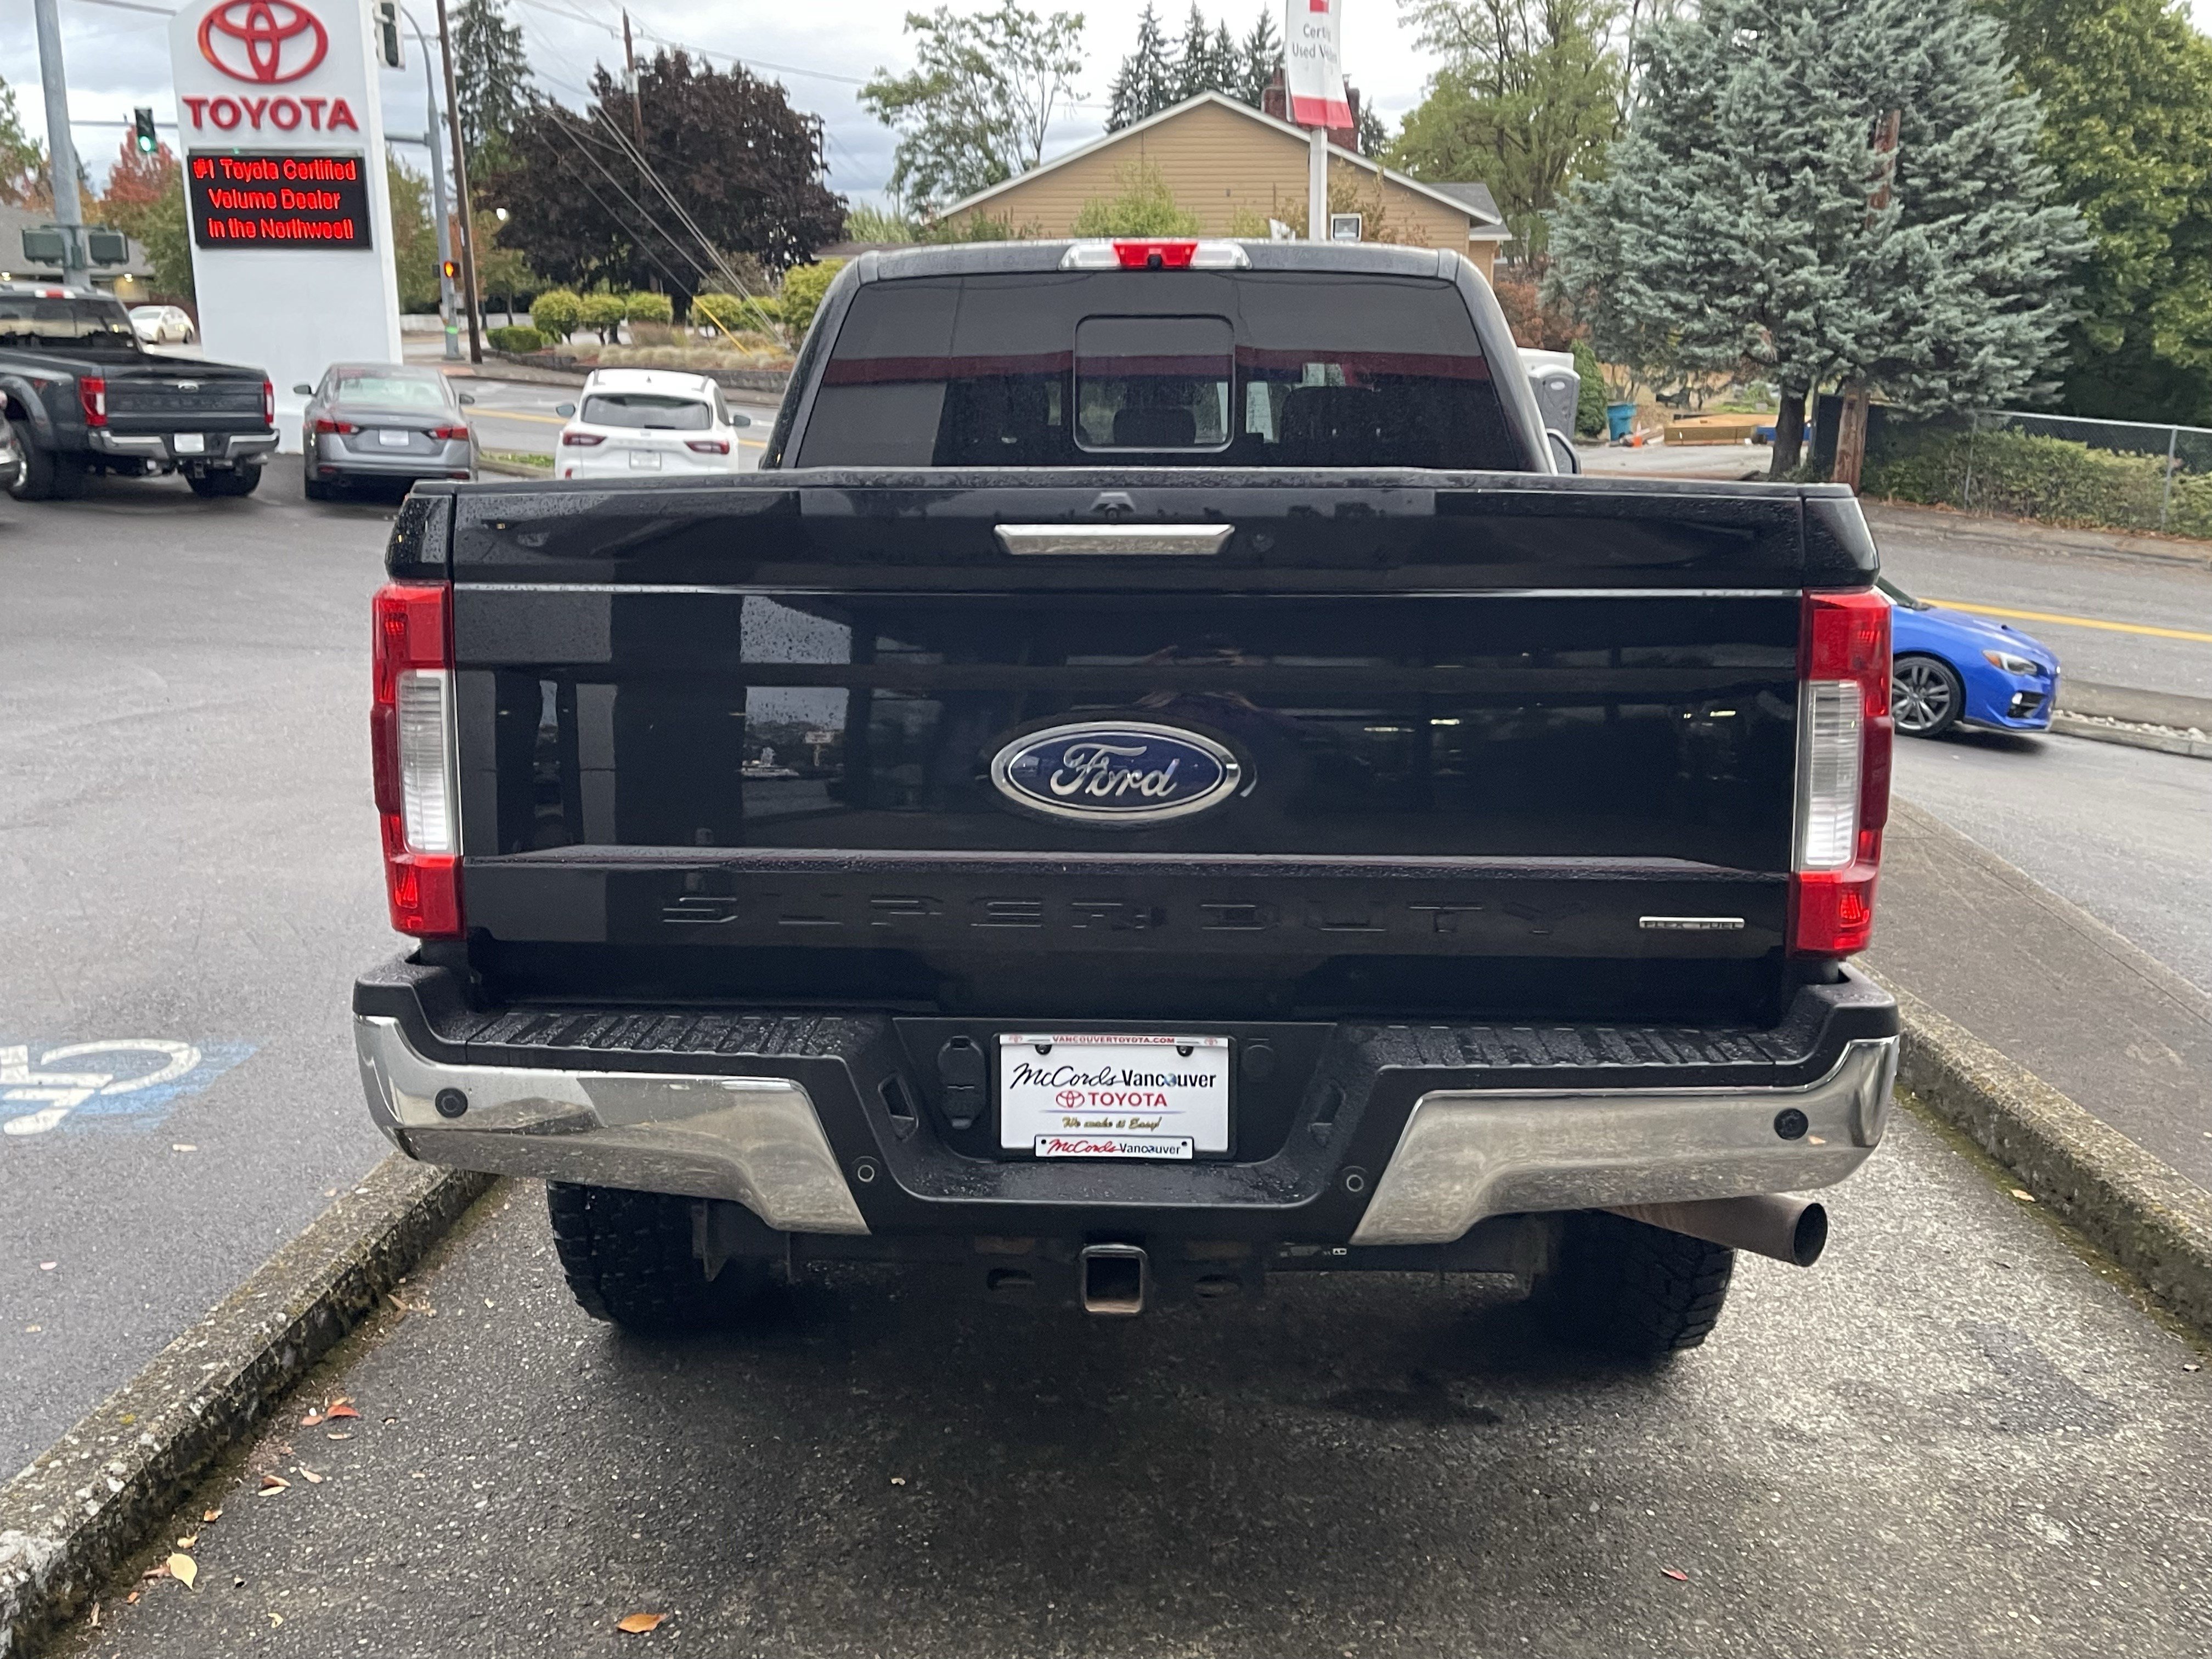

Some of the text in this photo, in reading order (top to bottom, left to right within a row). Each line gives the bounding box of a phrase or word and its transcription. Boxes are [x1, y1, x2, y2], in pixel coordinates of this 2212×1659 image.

[182, 95, 359, 131] TOYOTA
[193, 159, 357, 182] #1 Toyota Certified
[208, 189, 341, 210] Volume Dealer
[228, 218, 257, 239] the
[1050, 743, 1180, 797] Ford
[662, 895, 1587, 935] SUPER DUTY
[1088, 1092, 1167, 1107] TOYOTA
